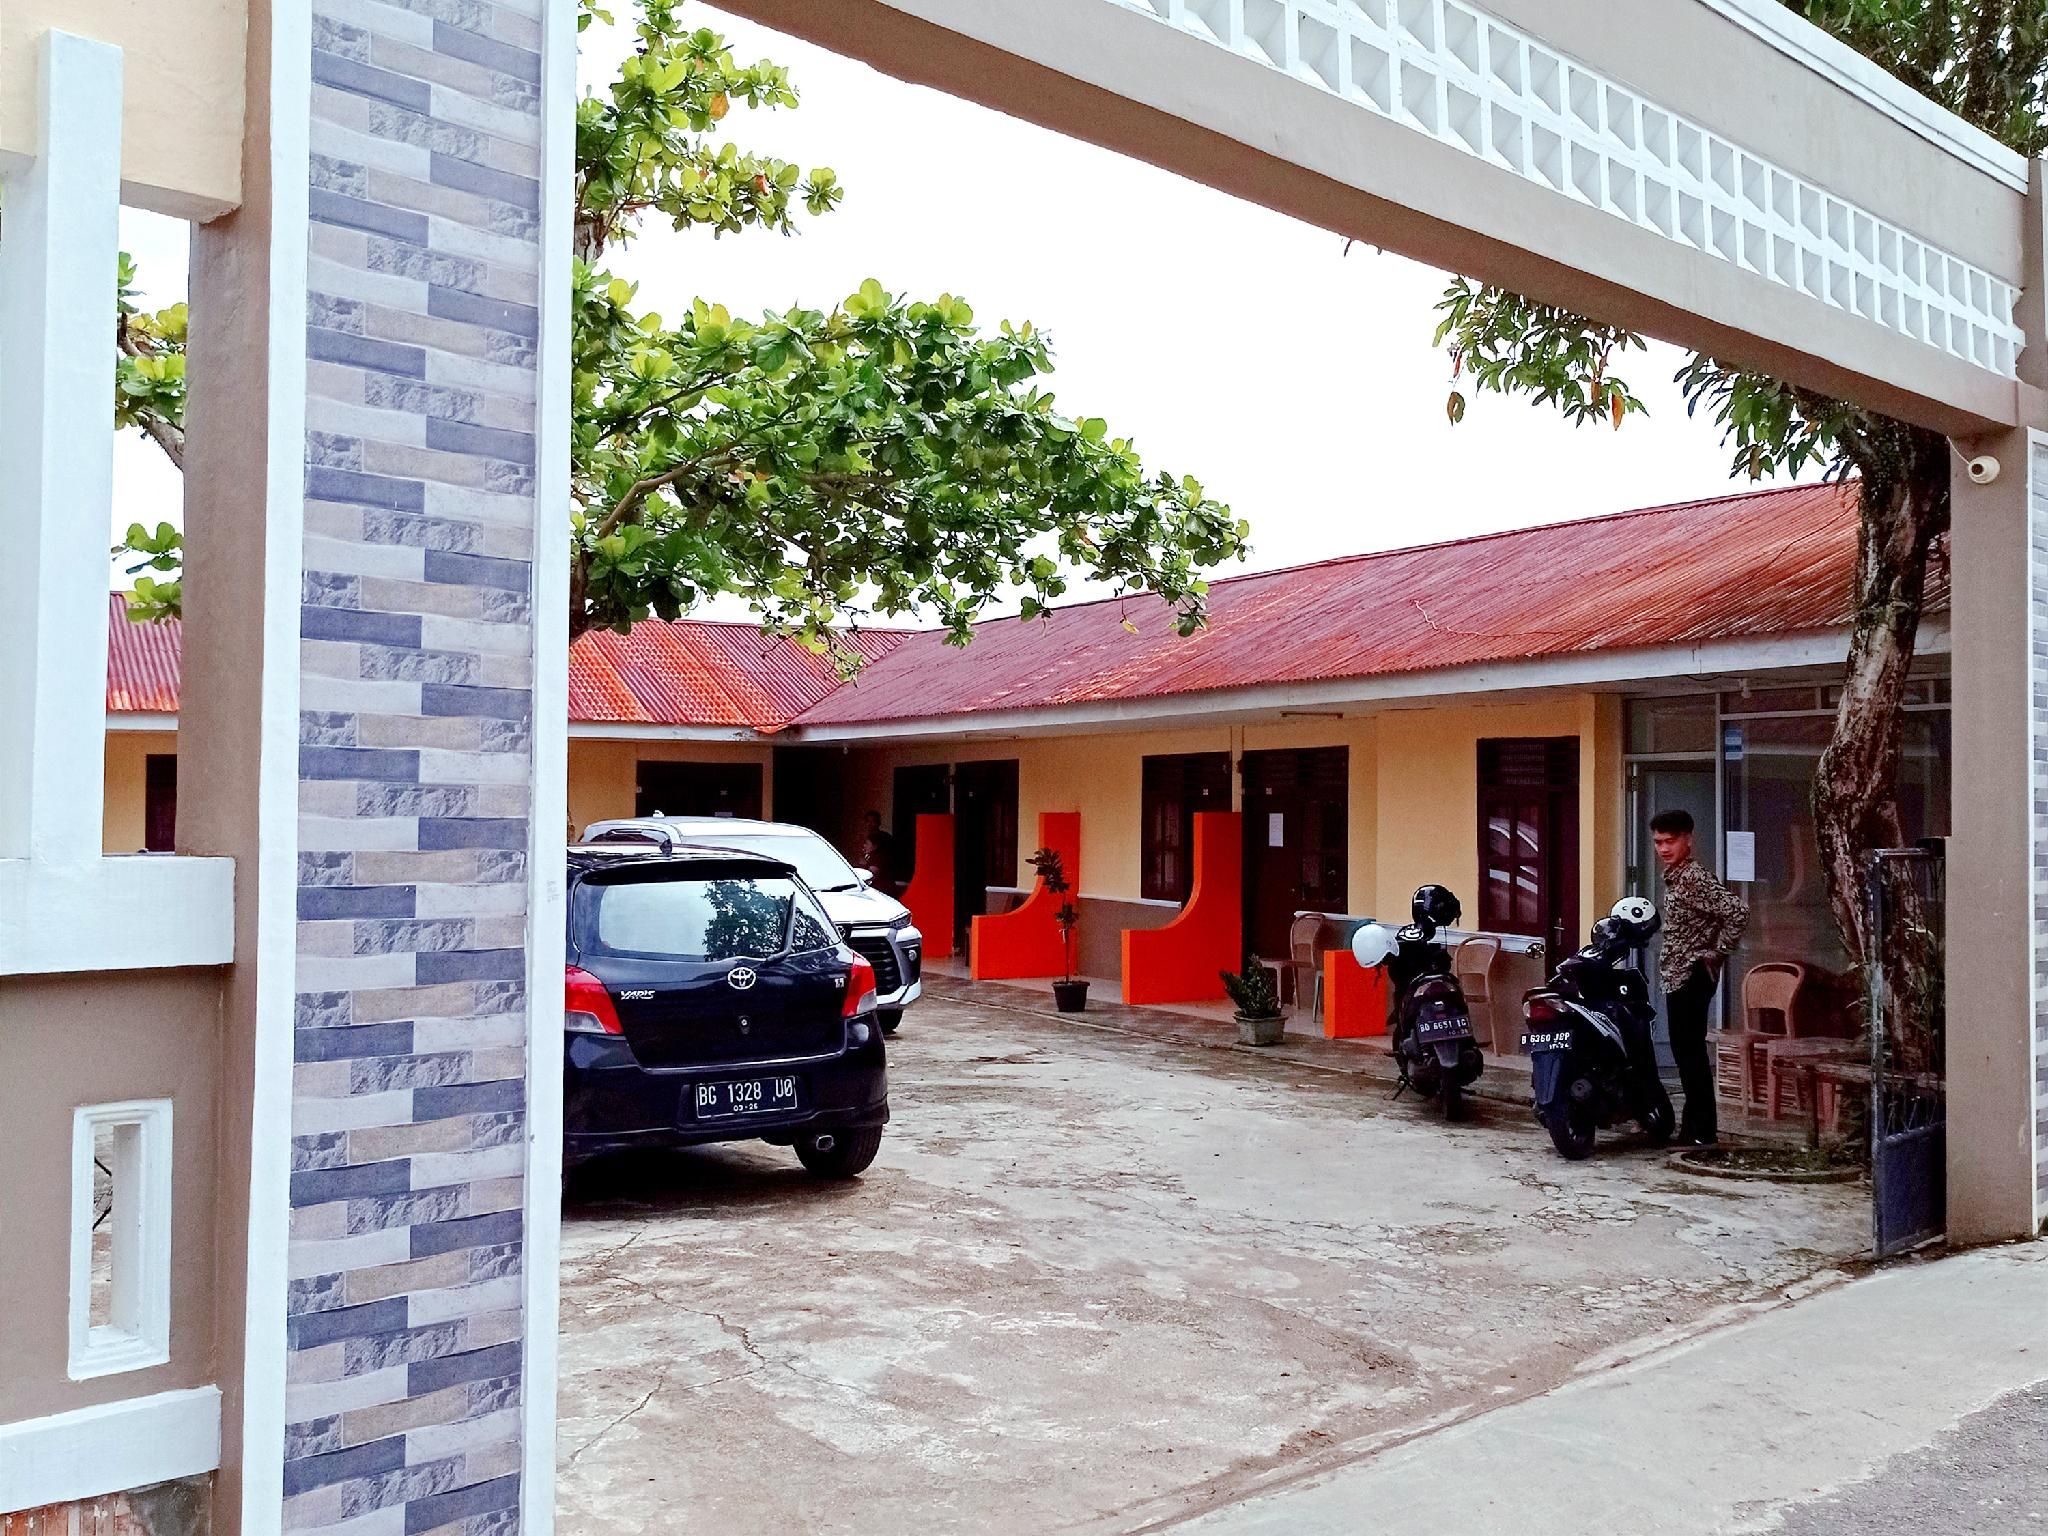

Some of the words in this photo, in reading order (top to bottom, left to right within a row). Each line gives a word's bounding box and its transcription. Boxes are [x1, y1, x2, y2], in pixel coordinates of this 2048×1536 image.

[620, 990, 656, 1000] YARIS
[1530, 1033, 1551, 1043] 6360
[698, 1085, 717, 1106] BG
[727, 1081, 762, 1103] 1328
